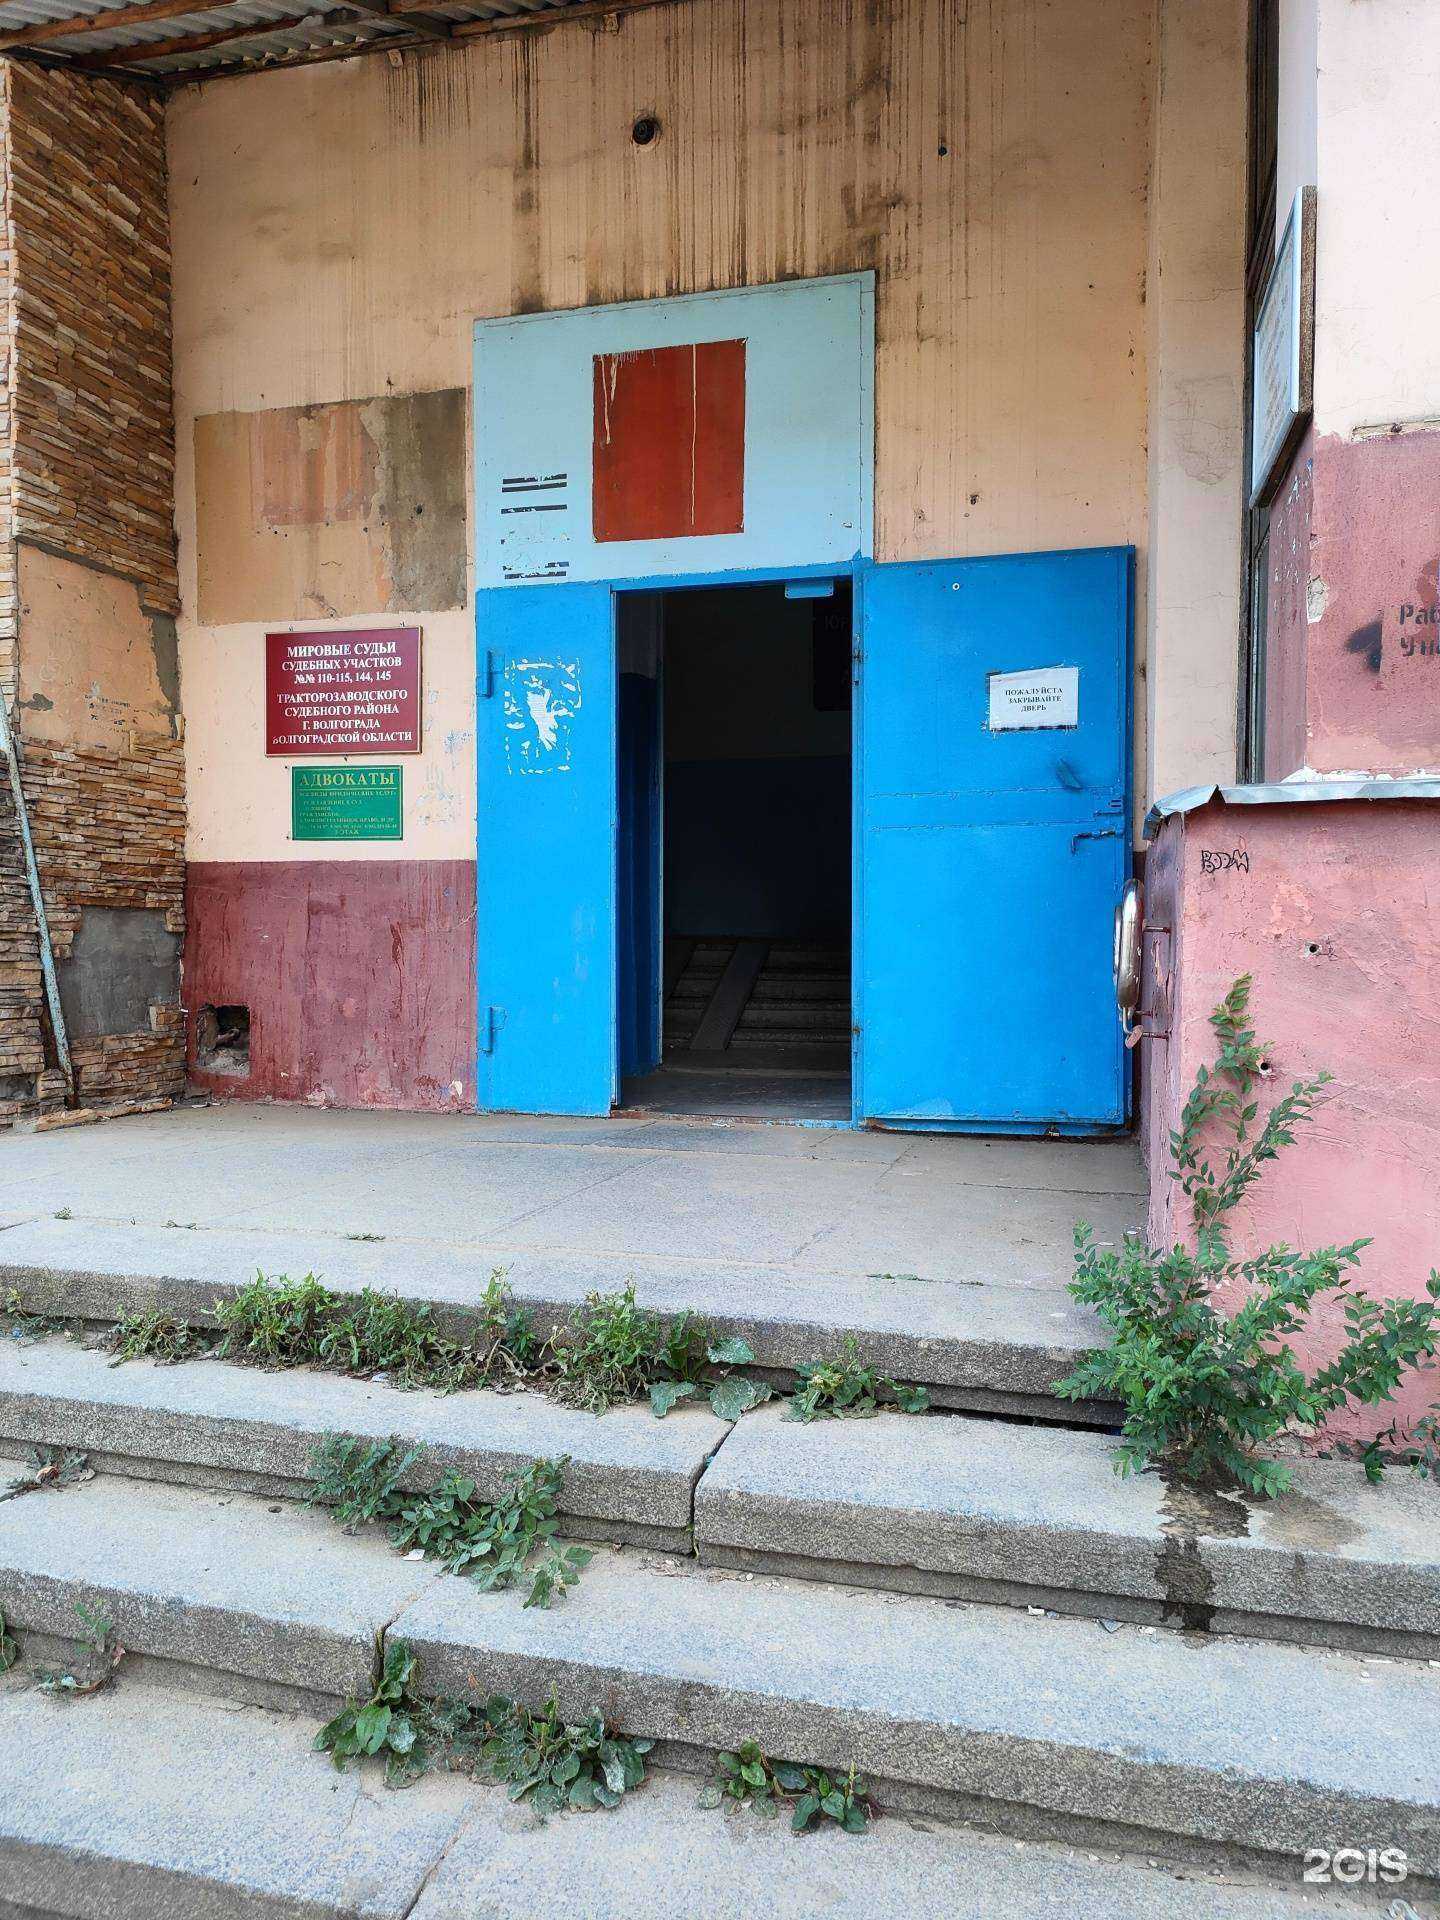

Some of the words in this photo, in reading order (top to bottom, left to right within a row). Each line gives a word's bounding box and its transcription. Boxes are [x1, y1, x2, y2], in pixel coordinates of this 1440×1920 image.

[287, 644, 351, 658] МИРОВЫЕ
[355, 642, 396, 656] СУДЬИ
[282, 659, 341, 672] СУДЕБНЫХ
[343, 657, 402, 669] УЧАСТКОВ
[355, 671, 374, 682] 144,
[375, 670, 391, 681] 145
[277, 689, 408, 704] ТРАКТОРОЗАВОДСКОГО
[1005, 687, 1064, 696] ПОЖАЛУЙСТА
[1008, 695, 1062, 704] ЗАКРЫВАЙТЕ
[284, 705, 352, 718] СУДЕБНОГО
[353, 703, 399, 715] РАЙОНА
[302, 721, 311, 730] Г.
[313, 719, 381, 730] ВОЛГОГРАДА
[362, 731, 412, 743] ОБЛАСТИ
[300, 772, 395, 788] АДВОКАТЫ
